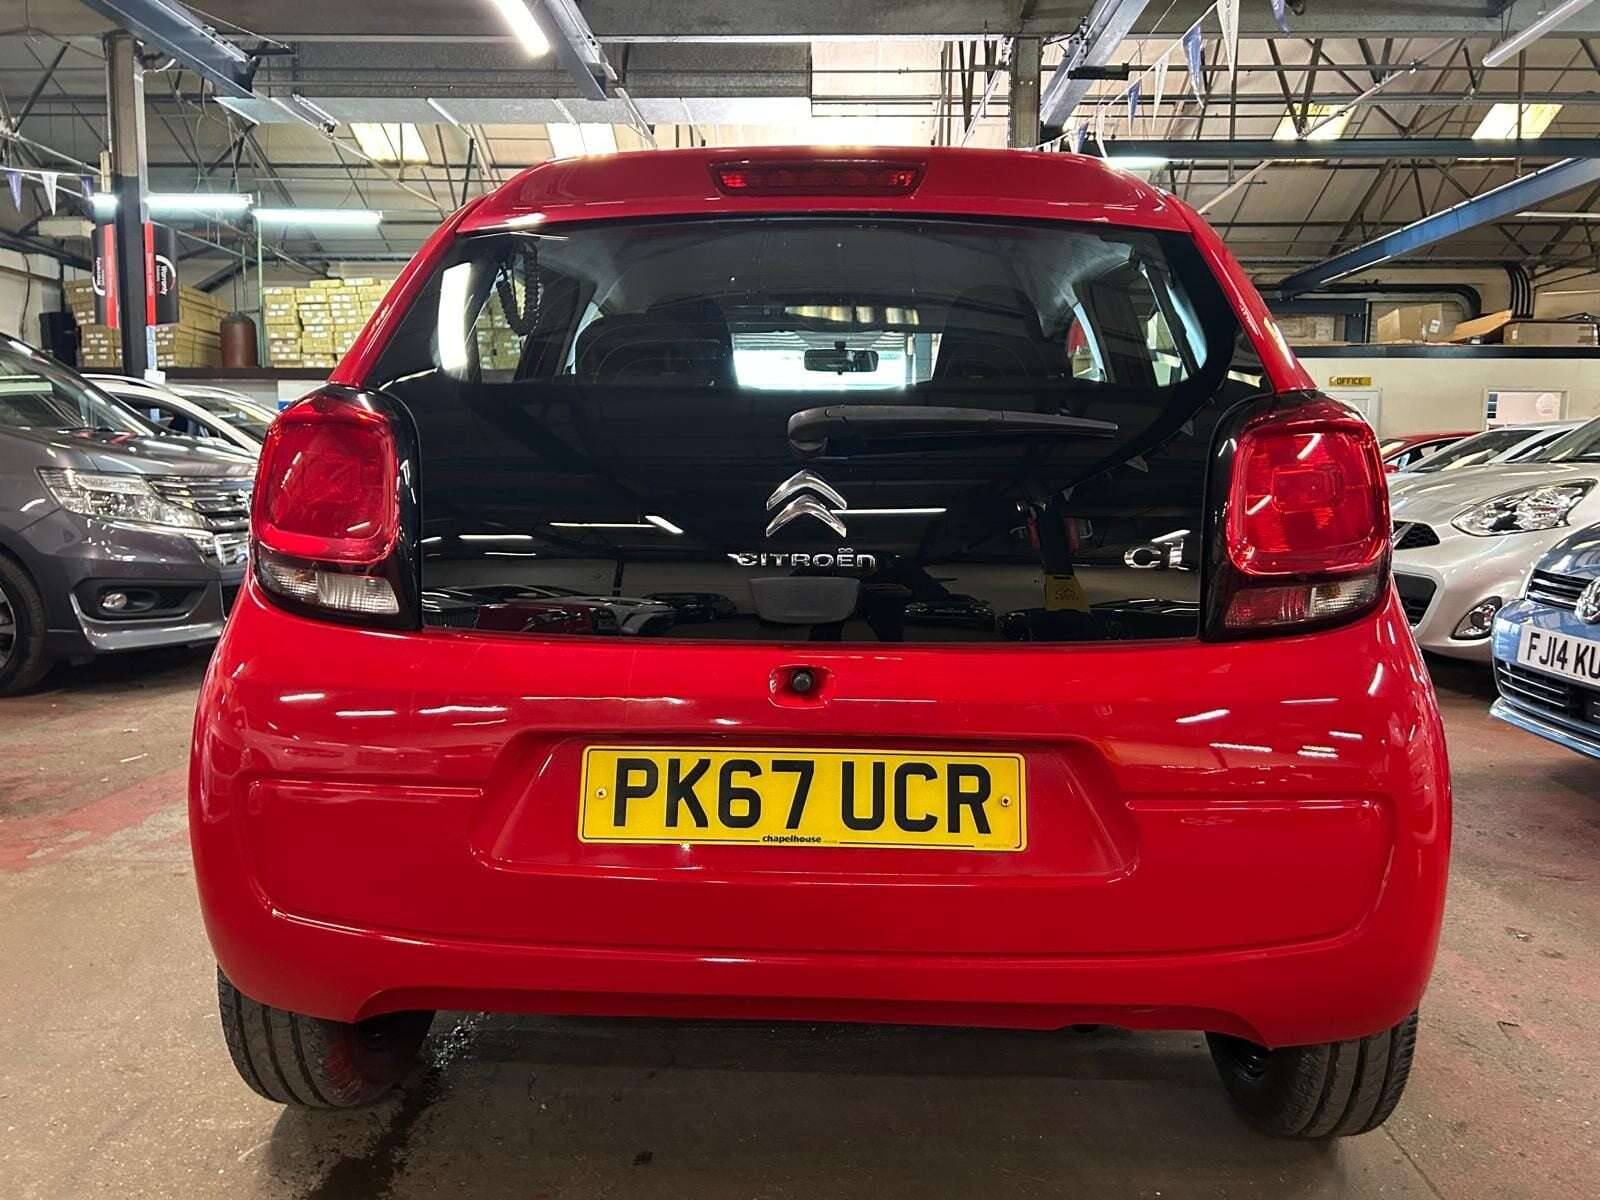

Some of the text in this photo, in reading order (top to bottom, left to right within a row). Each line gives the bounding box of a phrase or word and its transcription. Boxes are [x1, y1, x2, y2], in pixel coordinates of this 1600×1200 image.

[1336, 377, 1363, 385] OFFICE
[1527, 631, 1568, 671] FJ14
[613, 757, 992, 834] PK67 UCR
[762, 834, 822, 844] chapelhouse
